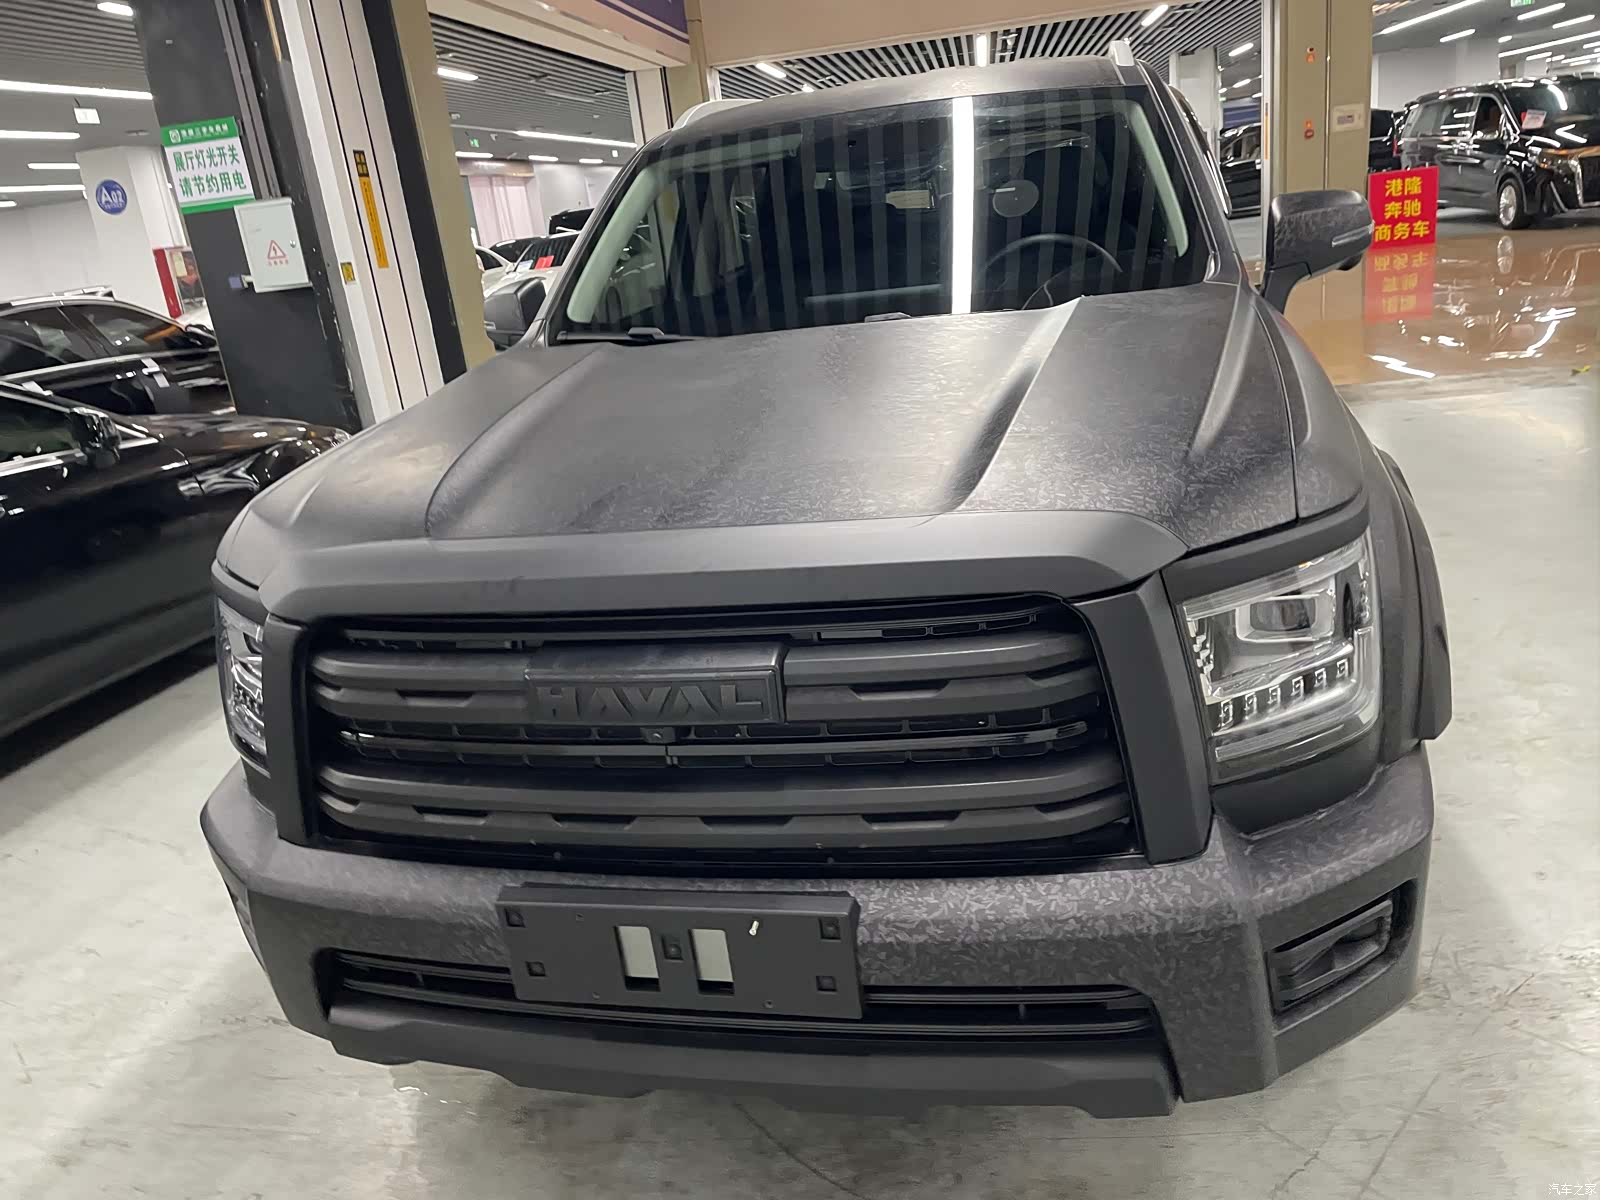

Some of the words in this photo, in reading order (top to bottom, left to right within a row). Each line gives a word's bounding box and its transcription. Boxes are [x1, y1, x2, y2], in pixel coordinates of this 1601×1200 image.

[173, 144, 240, 172] 展厅灯光开关
[179, 169, 246, 197] 请节约用电
[1385, 176, 1422, 198] 港隆
[1384, 198, 1421, 219] 奔驰
[1374, 220, 1430, 242] 商务车
[536, 685, 763, 721] HAVAL
